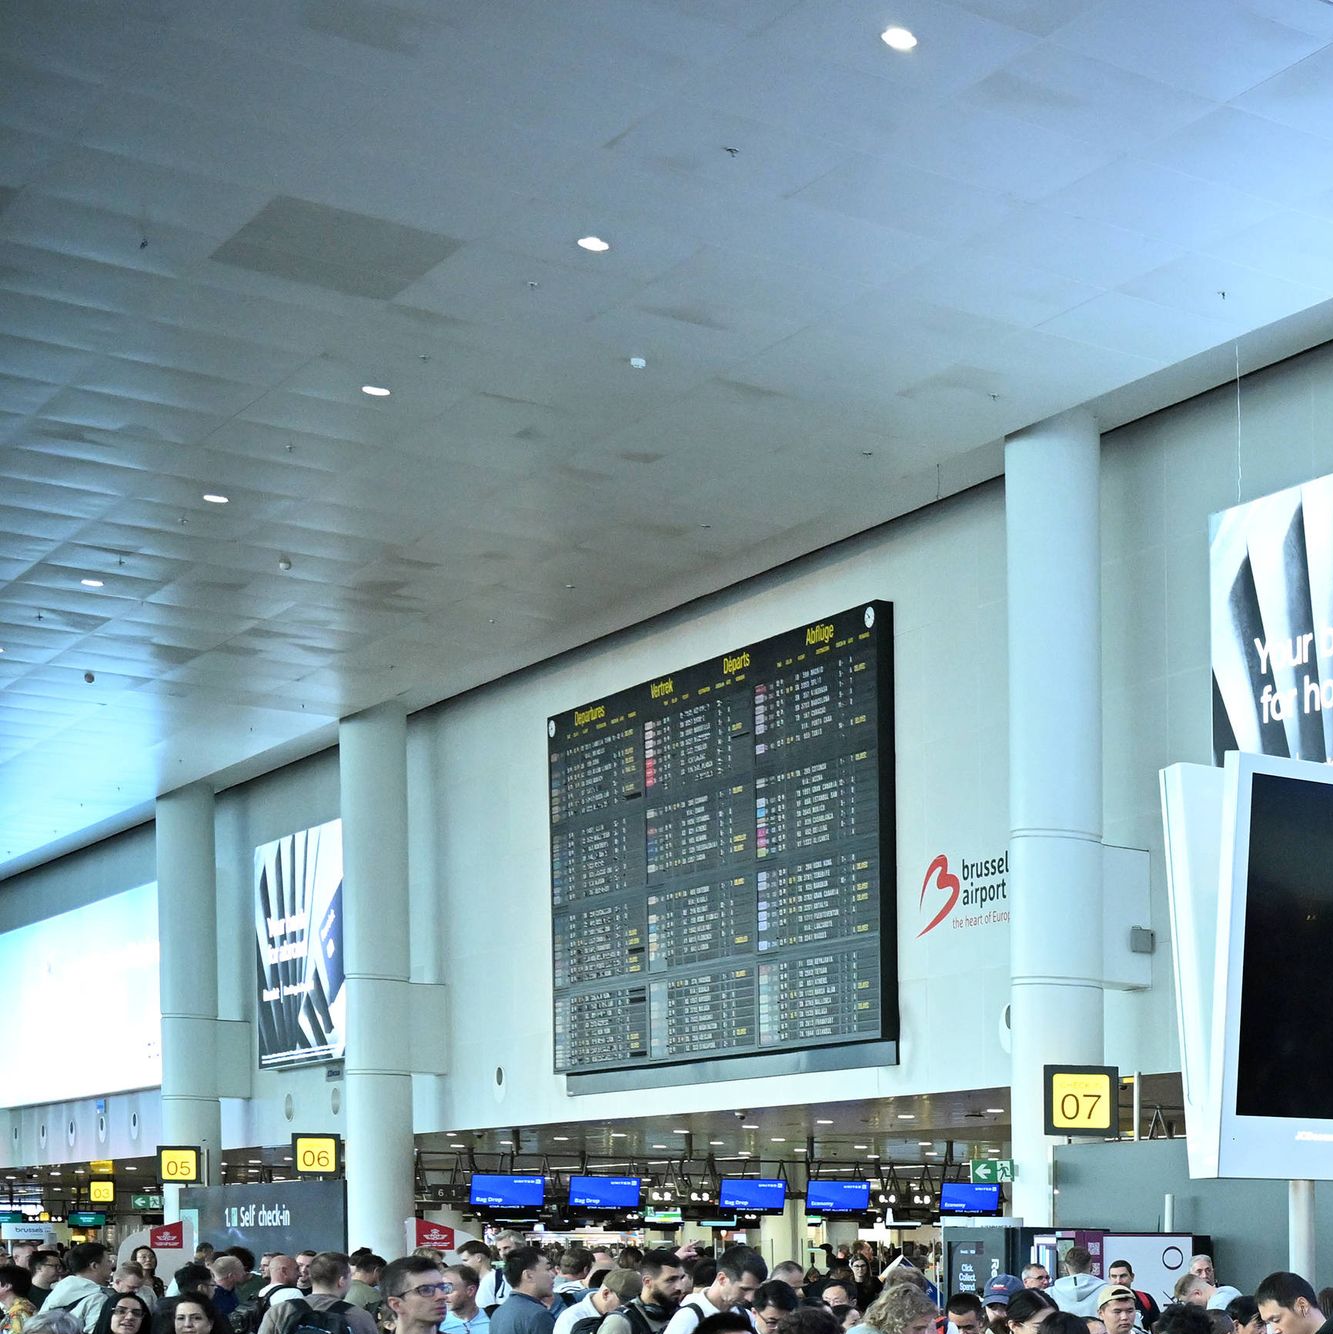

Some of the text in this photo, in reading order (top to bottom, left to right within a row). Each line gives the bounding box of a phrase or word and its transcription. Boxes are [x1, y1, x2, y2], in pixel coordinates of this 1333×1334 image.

[805, 624, 834, 646] Abflüge
[723, 651, 751, 676] Départs
[1254, 632, 1313, 675] Your
[650, 677, 674, 700] Vertrek
[1260, 684, 1298, 724] for
[575, 705, 605, 727] Departures
[962, 850, 1009, 881] brussel
[962, 878, 1007, 909] airport
[1061, 1093, 1102, 1120] 07
[166, 1160, 191, 1176] 05
[303, 1150, 330, 1167] 06
[94, 1188, 109, 1199] 03
[487, 1196, 503, 1204] Drop
[239, 1203, 255, 1226] Self
[258, 1203, 291, 1226] check-in
